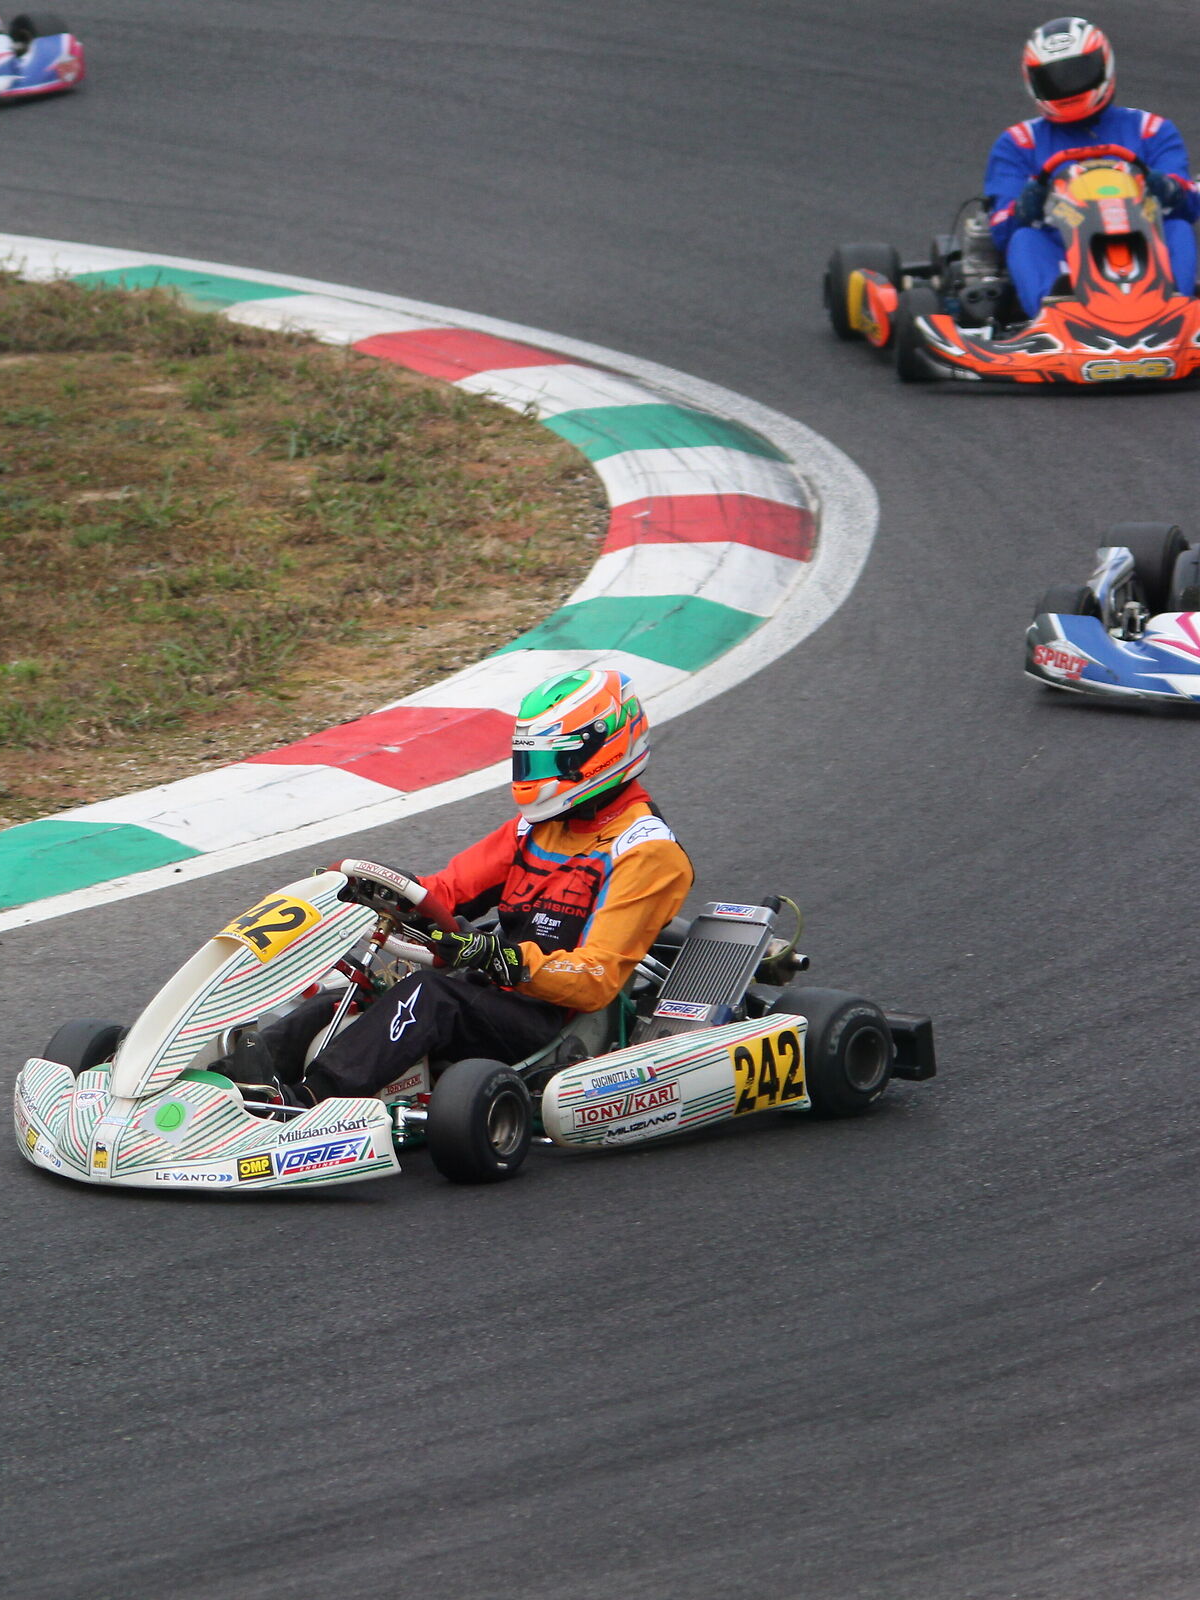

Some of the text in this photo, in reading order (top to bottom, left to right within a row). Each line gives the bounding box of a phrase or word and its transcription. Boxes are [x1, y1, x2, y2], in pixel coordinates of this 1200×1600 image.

[1033, 645, 1088, 674] SPIRIT
[658, 1001, 704, 1015] VORTEX
[591, 1071, 629, 1089] CUCINOTTA
[734, 1030, 803, 1116] 242
[278, 1117, 367, 1145] MilizianoKart
[240, 1161, 270, 1174] OMP
[276, 1137, 366, 1175] VORTEX
